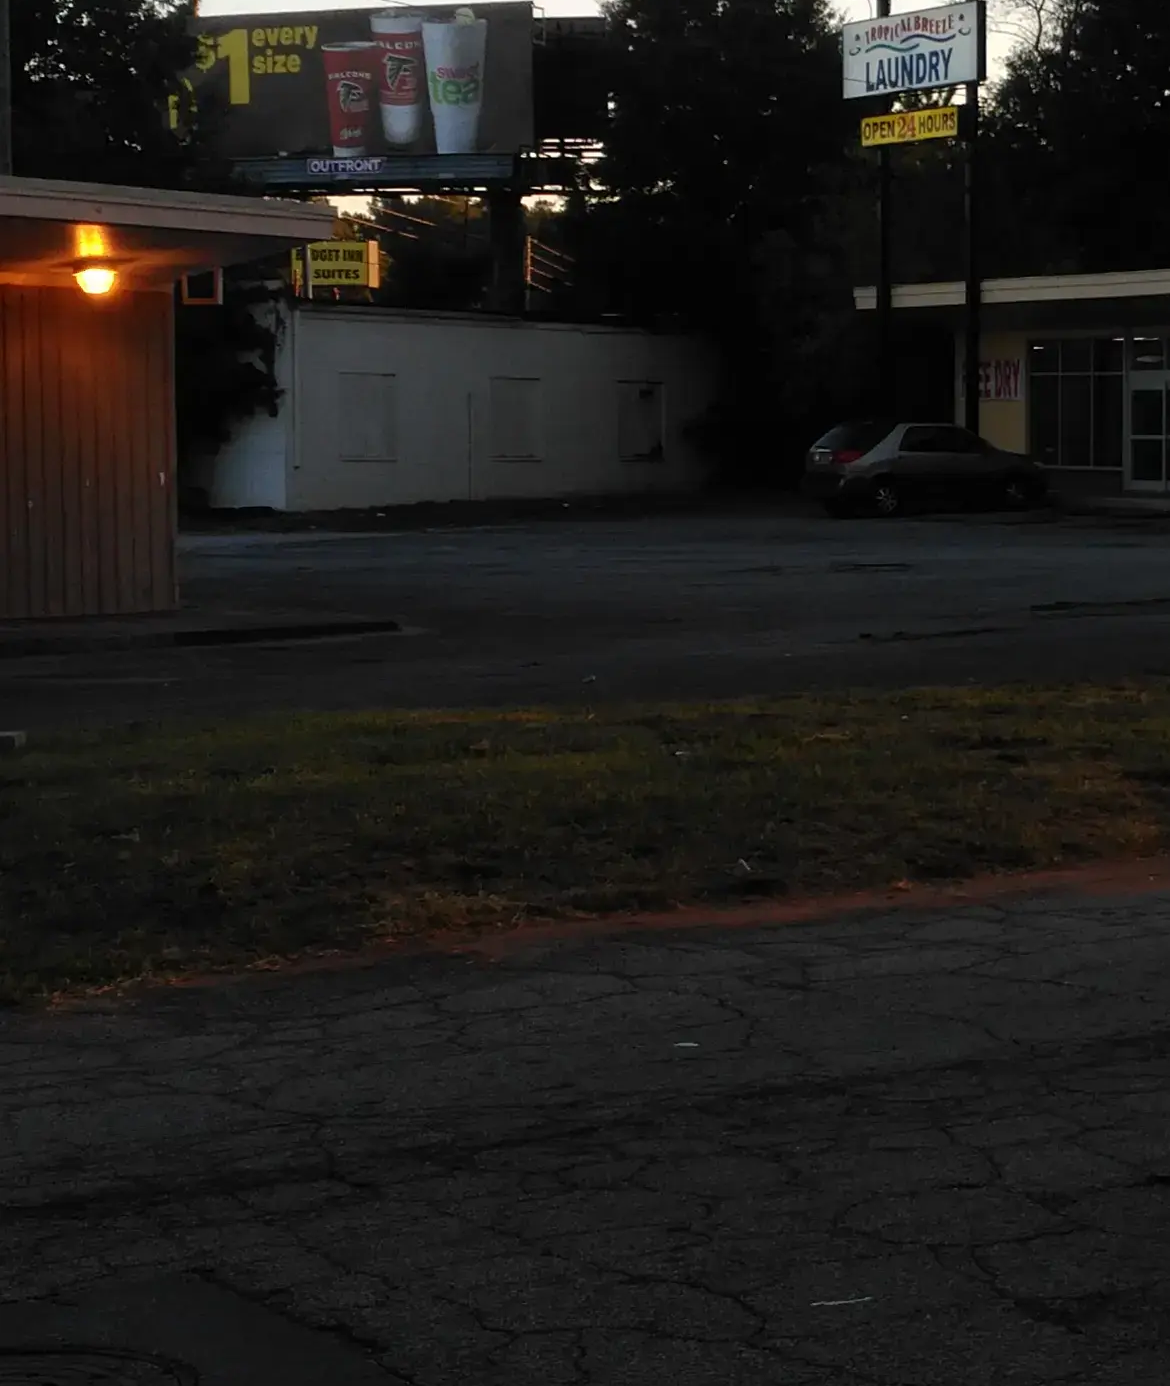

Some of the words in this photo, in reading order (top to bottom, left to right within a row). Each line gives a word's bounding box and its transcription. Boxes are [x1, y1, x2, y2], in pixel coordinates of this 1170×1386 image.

[252, 26, 318, 49] every
[865, 17, 911, 44] TROPICAL
[914, 15, 955, 34] BREEZE
[252, 51, 301, 74] size
[865, 48, 953, 93] LAUNDRY
[328, 70, 372, 81] FALCONS
[863, 120, 895, 141] OPEN
[897, 115, 916, 138] 24
[918, 113, 955, 134] HOURS
[310, 159, 382, 173] OUTFRONT
[313, 268, 360, 280] SUITES
[995, 359, 1020, 398] DRY
